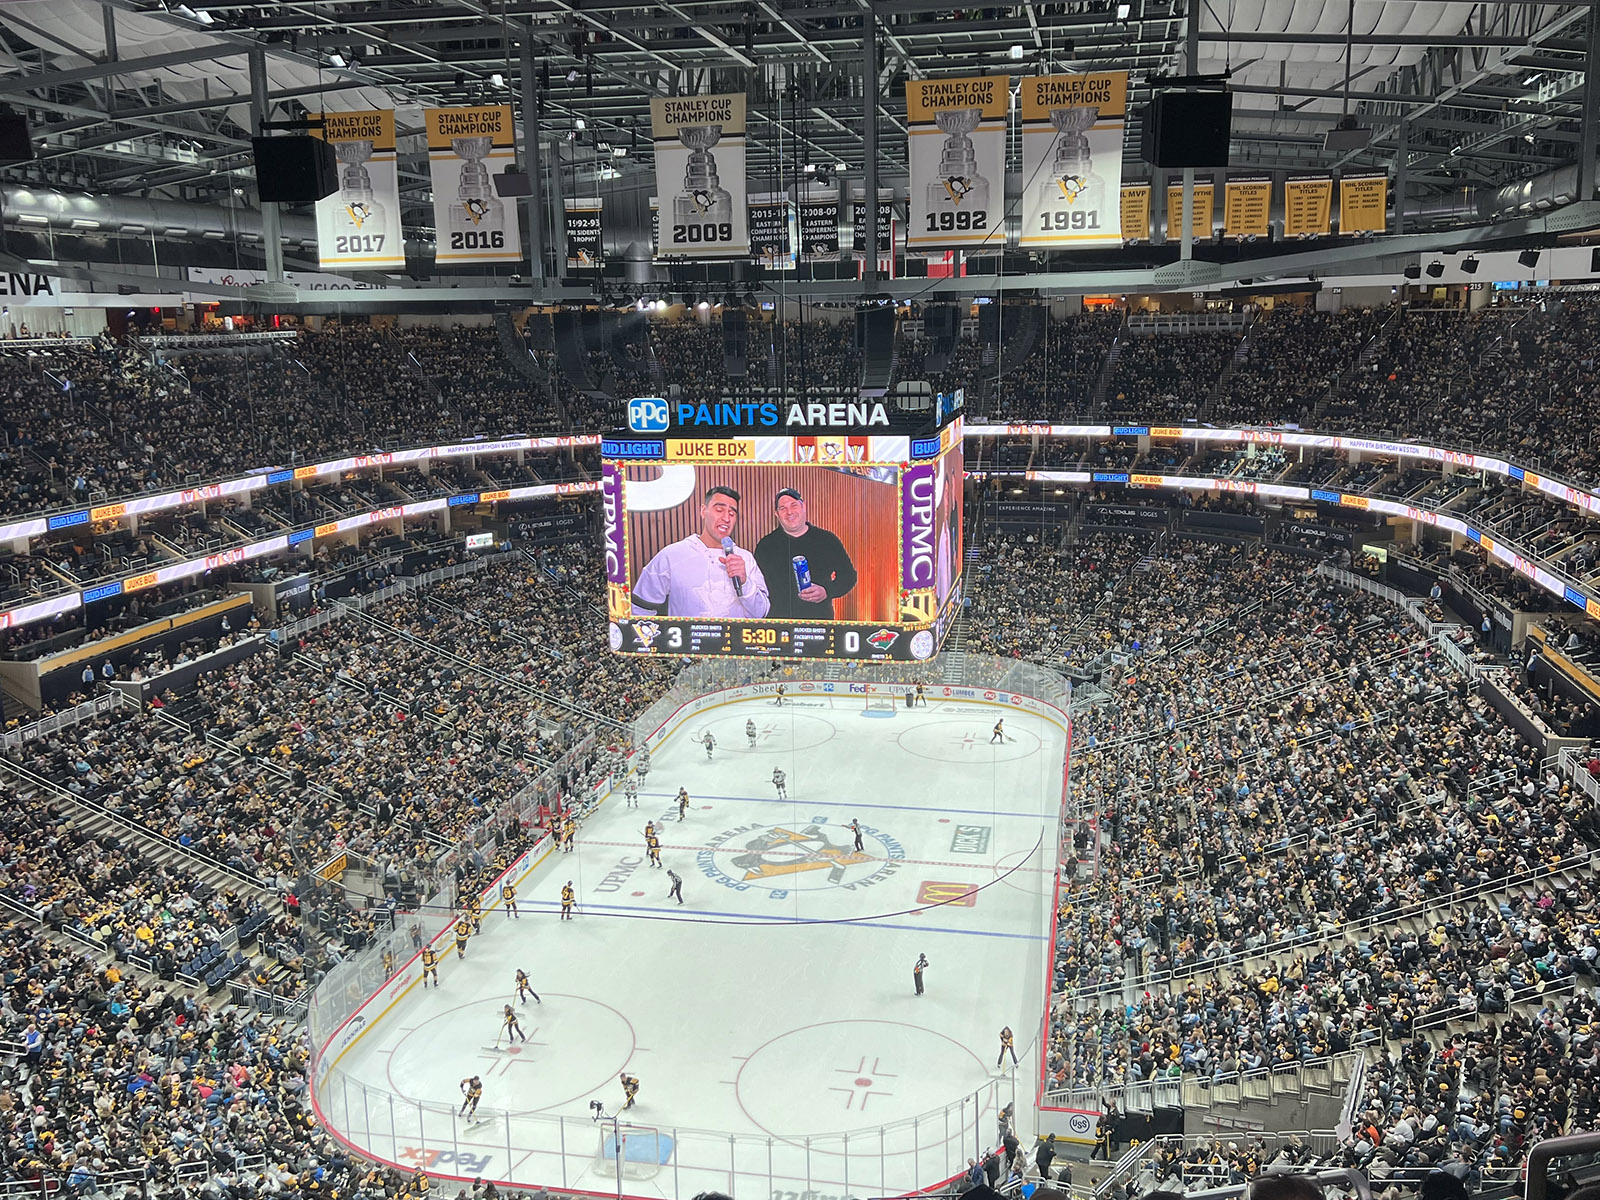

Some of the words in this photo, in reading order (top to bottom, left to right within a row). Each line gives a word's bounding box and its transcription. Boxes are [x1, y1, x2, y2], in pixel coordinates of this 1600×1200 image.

[922, 85, 971, 96] STANLEY
[972, 82, 993, 94] CUP
[1037, 82, 1088, 94] STANLEY
[1090, 80, 1111, 92] CUP
[665, 100, 710, 112] STANLEY
[712, 100, 731, 110] CUP
[922, 94, 993, 107] CHAMPIONS
[1037, 91, 1111, 106] CHAMPIONS
[326, 116, 361, 128] TANLEY
[363, 116, 382, 126] CUP
[438, 112, 478, 124] STANLEY
[482, 111, 501, 122] CUP
[666, 110, 732, 124] CHAMPIONS
[440, 122, 501, 135] CHAMPIONS
[802, 208, 838, 217] 2008-09
[854, 206, 890, 216] 20-08
[568, 220, 600, 228] 1992-93
[927, 211, 987, 231] 1992
[1041, 210, 1101, 230] 1991
[452, 231, 504, 250] 2016
[674, 224, 732, 243] 2009
[336, 234, 386, 253] 2017
[631, 402, 667, 429] PPG
[678, 403, 779, 426] PAINTS
[786, 403, 890, 426] ARENA
[624, 443, 661, 455] LIGHT
[676, 443, 713, 456] JUKE
[718, 442, 747, 456] BOX
[482, 492, 497, 500] JUKE
[94, 507, 111, 519] JUKE
[111, 504, 126, 516] BOX
[52, 517, 67, 529] BUD
[67, 513, 88, 525] LIGHT
[603, 475, 618, 576] UPMC
[911, 474, 933, 582] UPMC
[127, 577, 144, 590] JUKE
[144, 573, 158, 586] BOX
[84, 589, 99, 601] BUD
[99, 583, 120, 597] LIGHT
[668, 627, 683, 648] 3
[742, 628, 776, 644] 5:30
[845, 632, 860, 652] 0
[850, 684, 877, 693] FedEx
[953, 689, 975, 697] LUMBER
[99, 700, 111, 710] 101
[24, 730, 39, 741] 101
[878, 832, 906, 860] PAINTS
[952, 826, 982, 852] DICK'S
[696, 850, 717, 879] PAINTS
[594, 856, 643, 893] UPMC
[714, 876, 752, 891] PPG
[1072, 1120, 1087, 1129] USS
[398, 1146, 492, 1173] FedEx
